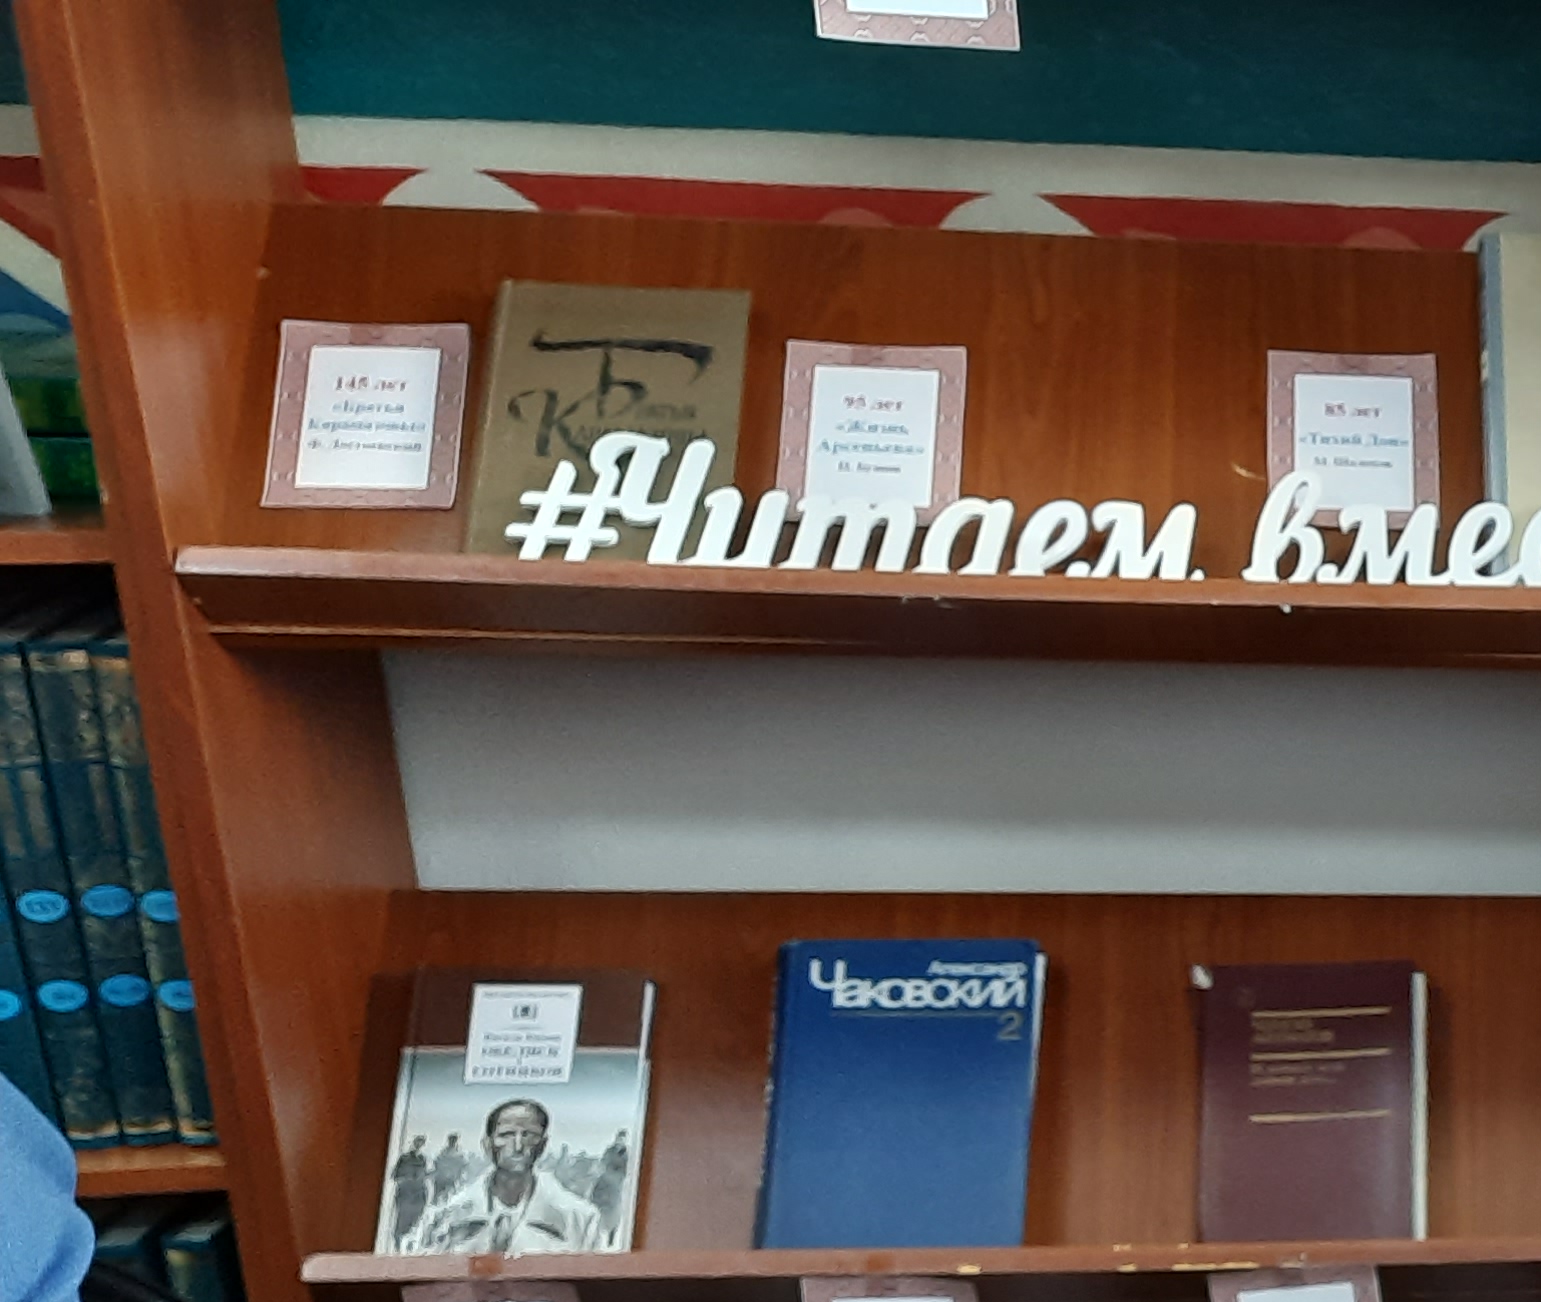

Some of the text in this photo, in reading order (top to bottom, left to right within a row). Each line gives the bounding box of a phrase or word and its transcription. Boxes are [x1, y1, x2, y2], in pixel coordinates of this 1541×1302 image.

[505, 432, 1208, 577] #Читаем
[808, 957, 1029, 1009] Чаковский
[996, 1012, 1022, 1040] 2
